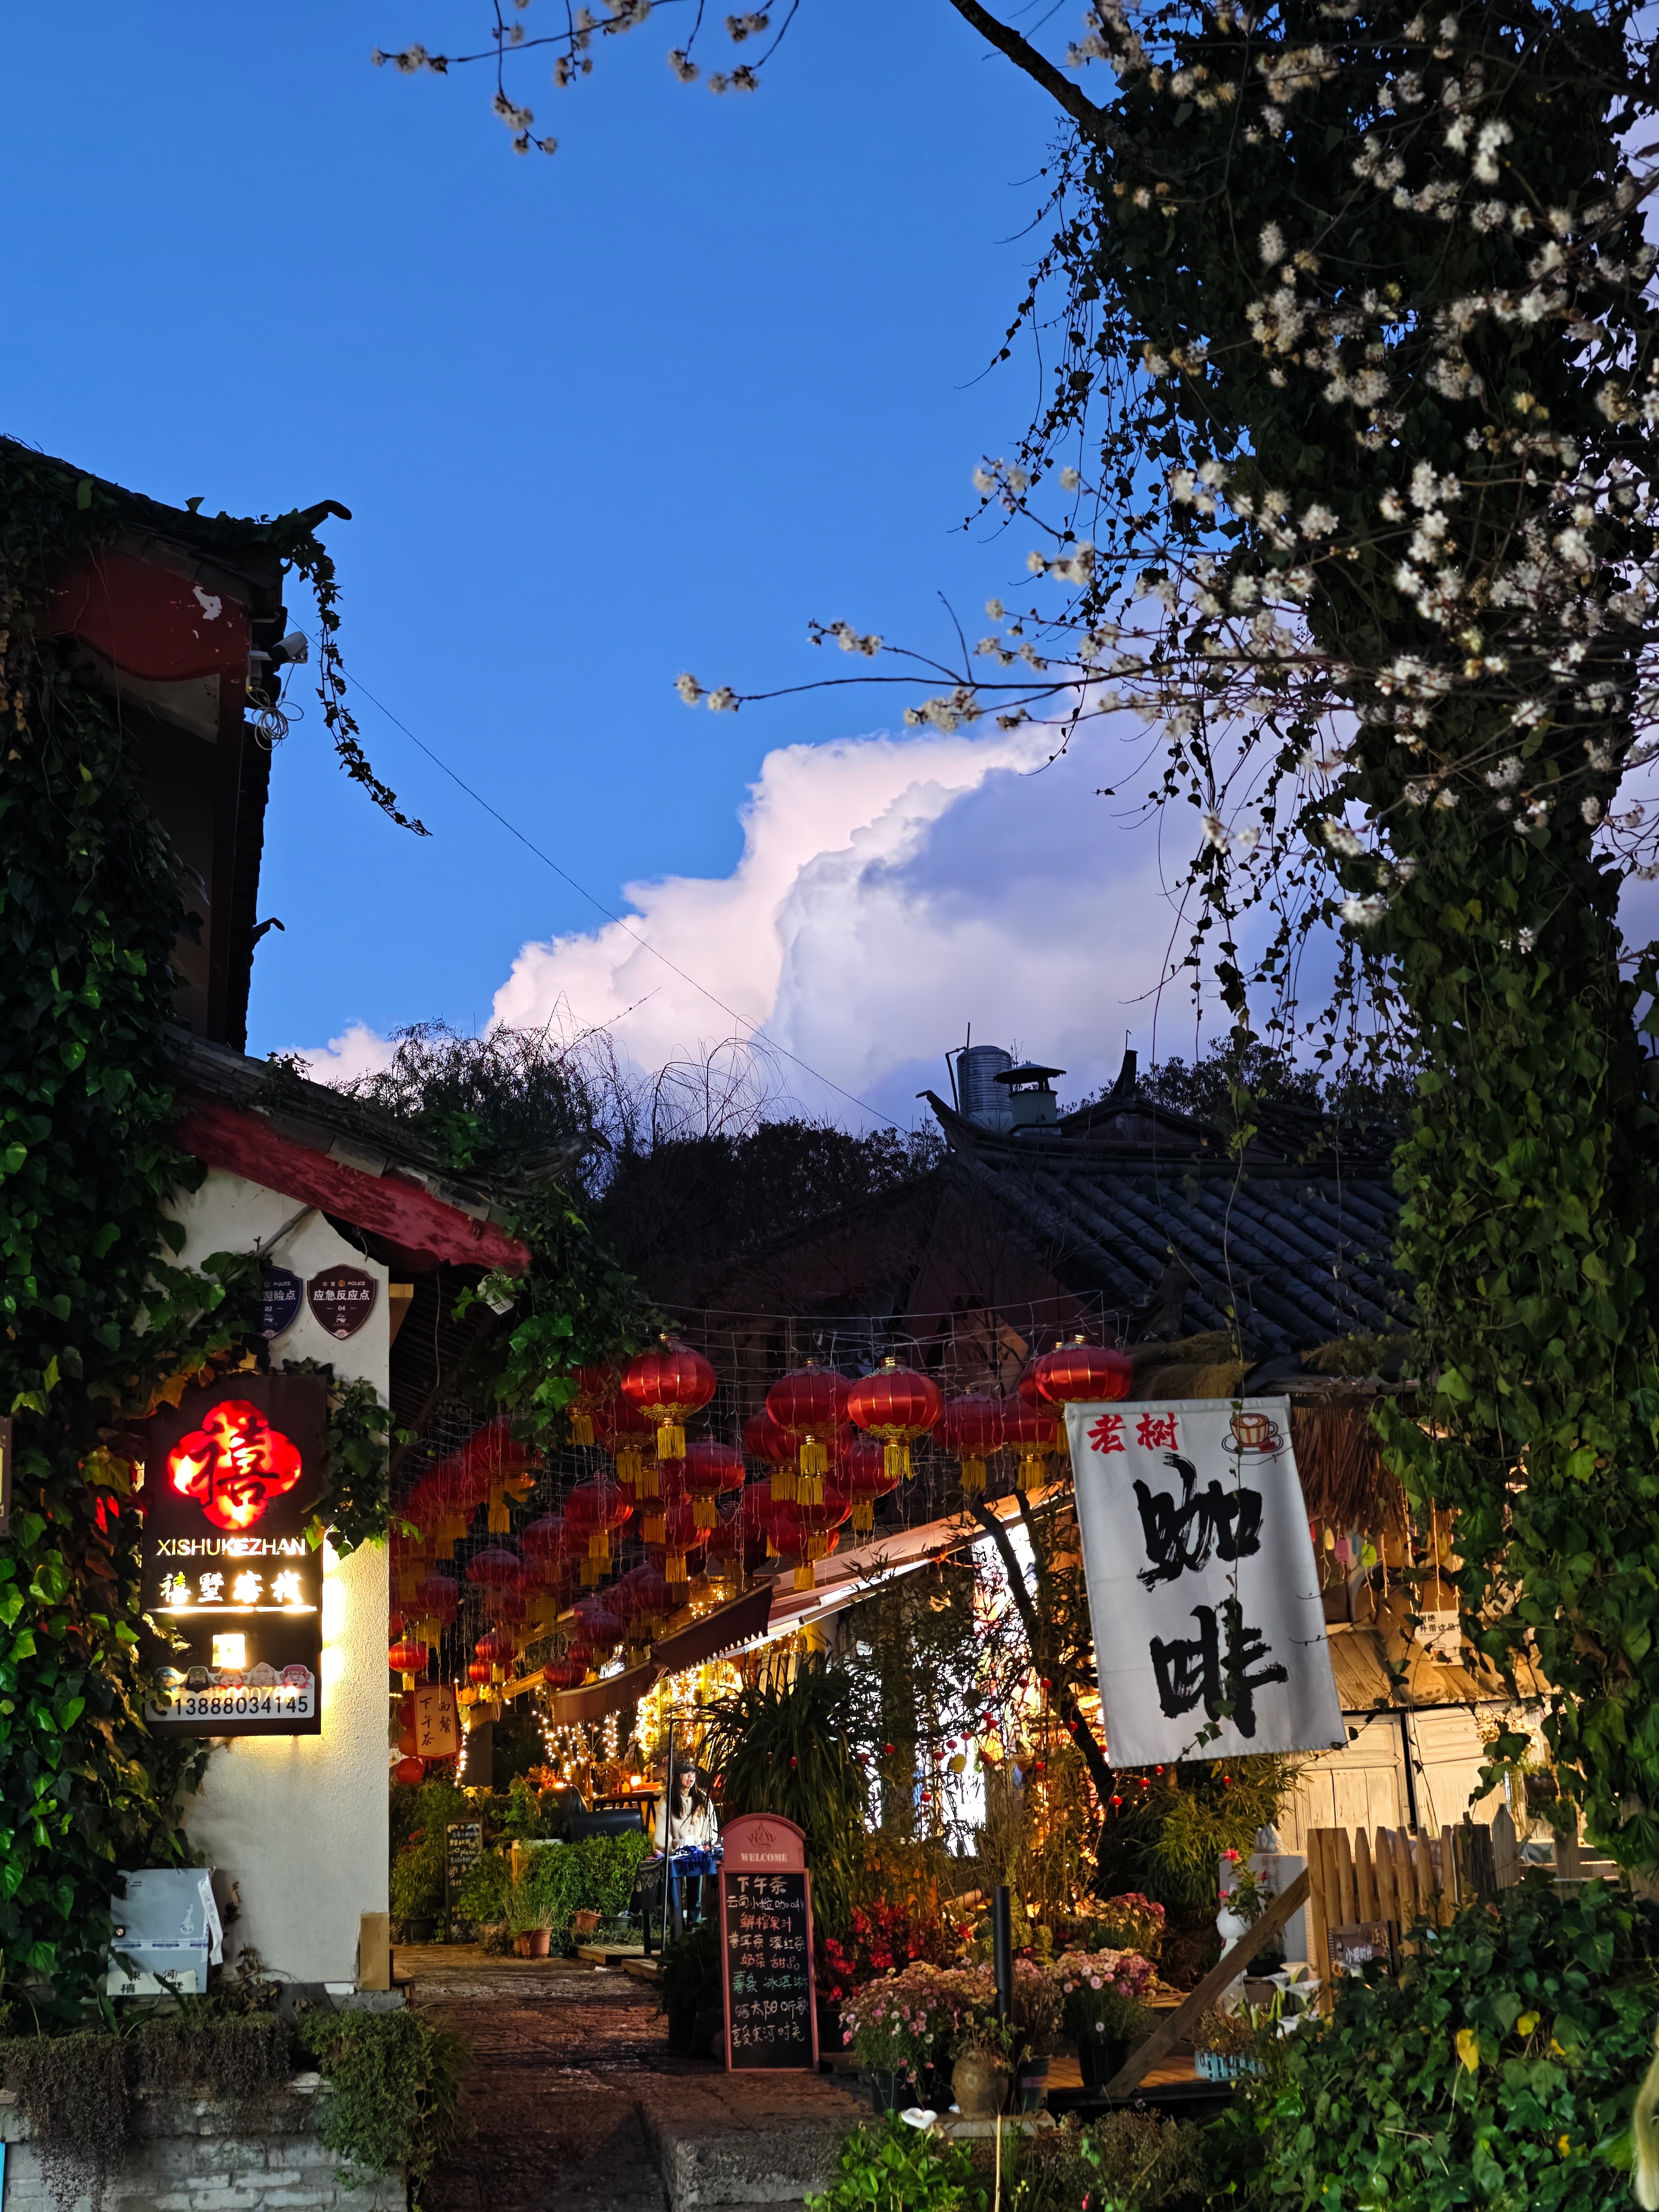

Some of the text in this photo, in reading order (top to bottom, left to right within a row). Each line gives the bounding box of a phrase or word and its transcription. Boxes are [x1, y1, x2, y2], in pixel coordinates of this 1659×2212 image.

[313, 1289, 369, 1301] 应急反应点
[1086, 1412, 1179, 1454] 老树
[188, 1416, 280, 1507] 禧
[156, 1537, 306, 1556] XISHUKEZHAN
[159, 1569, 304, 1605] 禧墅客栈
[1131, 1452, 1290, 1738] 咖啡
[174, 1696, 308, 1715] 13888034145
[420, 1697, 435, 1746] 下午茶
[439, 1702, 452, 1734] 西餐
[741, 1853, 788, 1862] WELCOME
[737, 1876, 787, 1895] 下午茶
[739, 1912, 792, 1932] 鲜榨果汁
[728, 1931, 805, 1952] 普洱茶 滇红茶
[740, 1952, 800, 1971] 奶茶 甜品
[732, 1971, 808, 1994] 薯条 冰淇淋
[735, 1997, 809, 2021] 晒太阳 听歌
